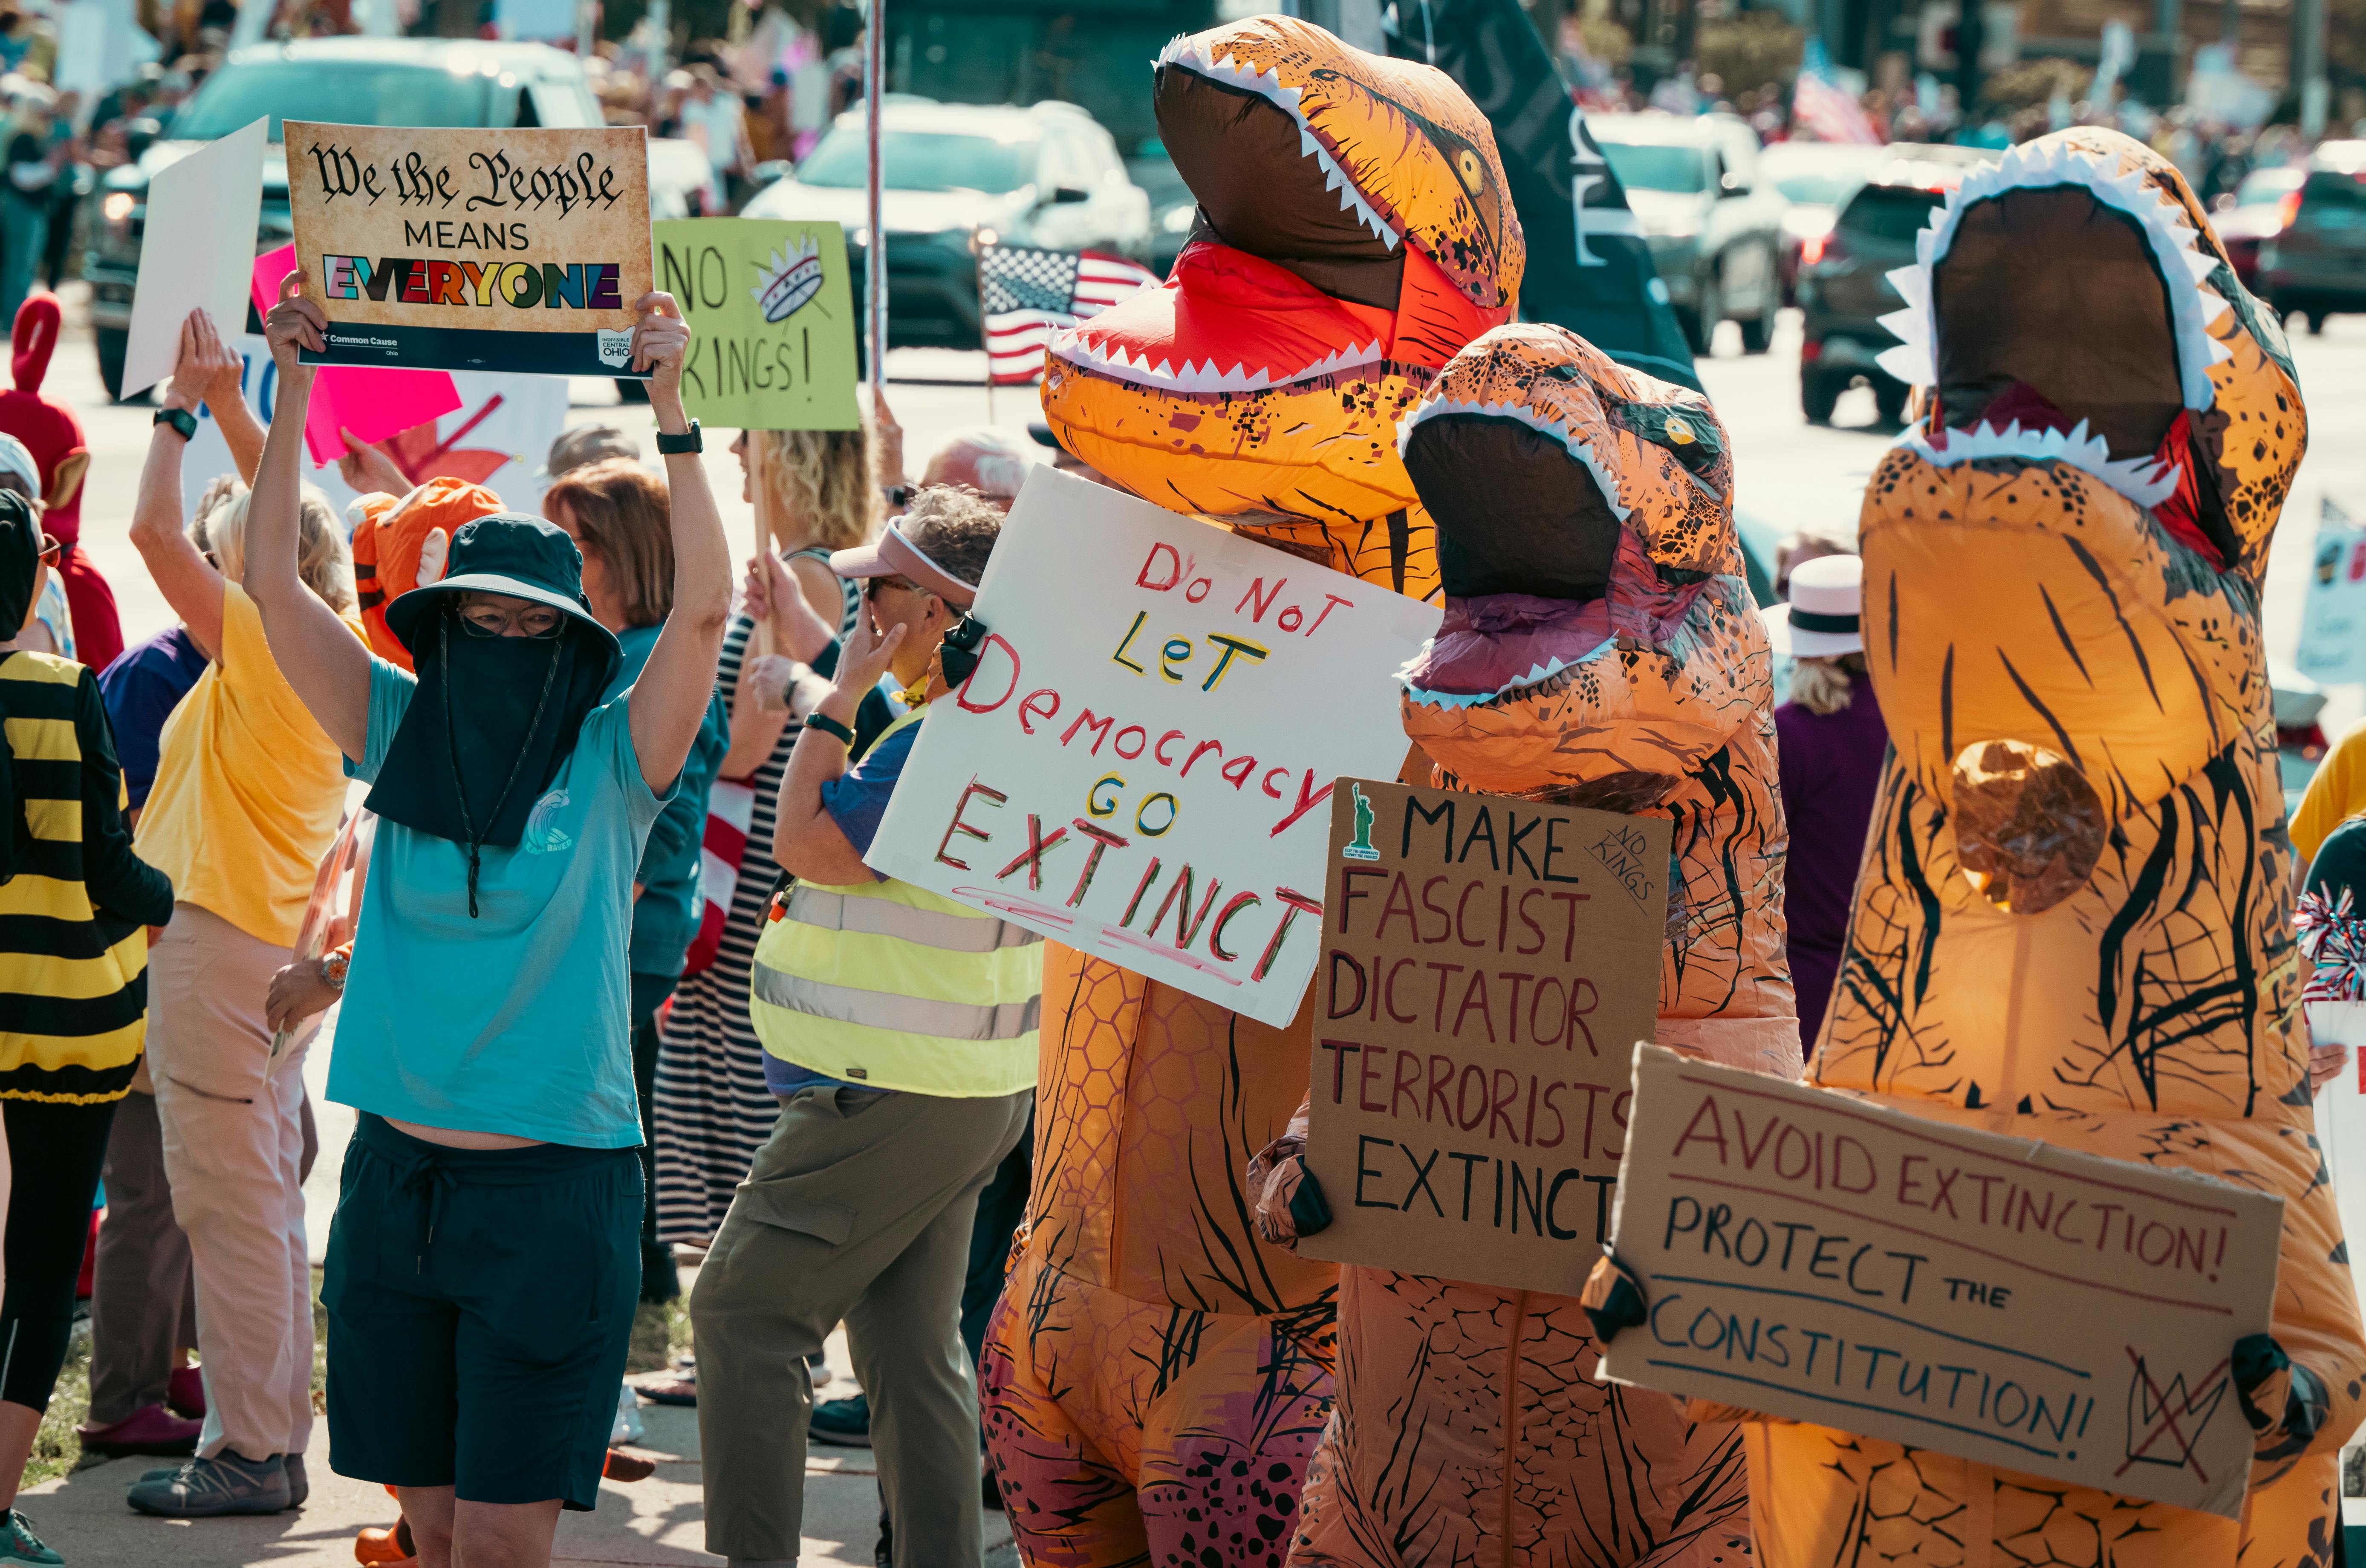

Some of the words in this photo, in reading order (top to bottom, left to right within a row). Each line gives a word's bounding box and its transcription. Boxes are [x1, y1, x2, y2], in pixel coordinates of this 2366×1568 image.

[308, 142, 386, 206] We
[391, 152, 460, 209] the
[466, 148, 624, 221] People
[404, 219, 529, 250] MEANS
[322, 254, 622, 310] EVERYONE
[662, 242, 728, 312] NO
[330, 334, 369, 344] Common
[370, 337, 398, 346] Cause
[603, 347, 630, 356] OHIO
[681, 326, 812, 403] KINGS!
[1136, 542, 1212, 604] Do
[547, 839, 572, 852] BAUER
[934, 772, 1324, 982] EXTINCT
[1401, 794, 1580, 884] MAKE
[1591, 834, 1655, 900] KINGS
[1615, 825, 1646, 855] NO
[1338, 866, 1592, 962] FASCIST
[1327, 949, 1600, 1058] DICTATOR
[1320, 1037, 1634, 1160] TERRORISTS
[1355, 1134, 1618, 1244] EXTINCT
[1673, 1095, 1878, 1195] AVOID
[1898, 1154, 2227, 1282] EXTINCTION!
[1664, 1195, 1929, 1305] PROTECT
[1944, 1278, 2014, 1310] THE
[1650, 1293, 2095, 1461] CONSTITUTION!
